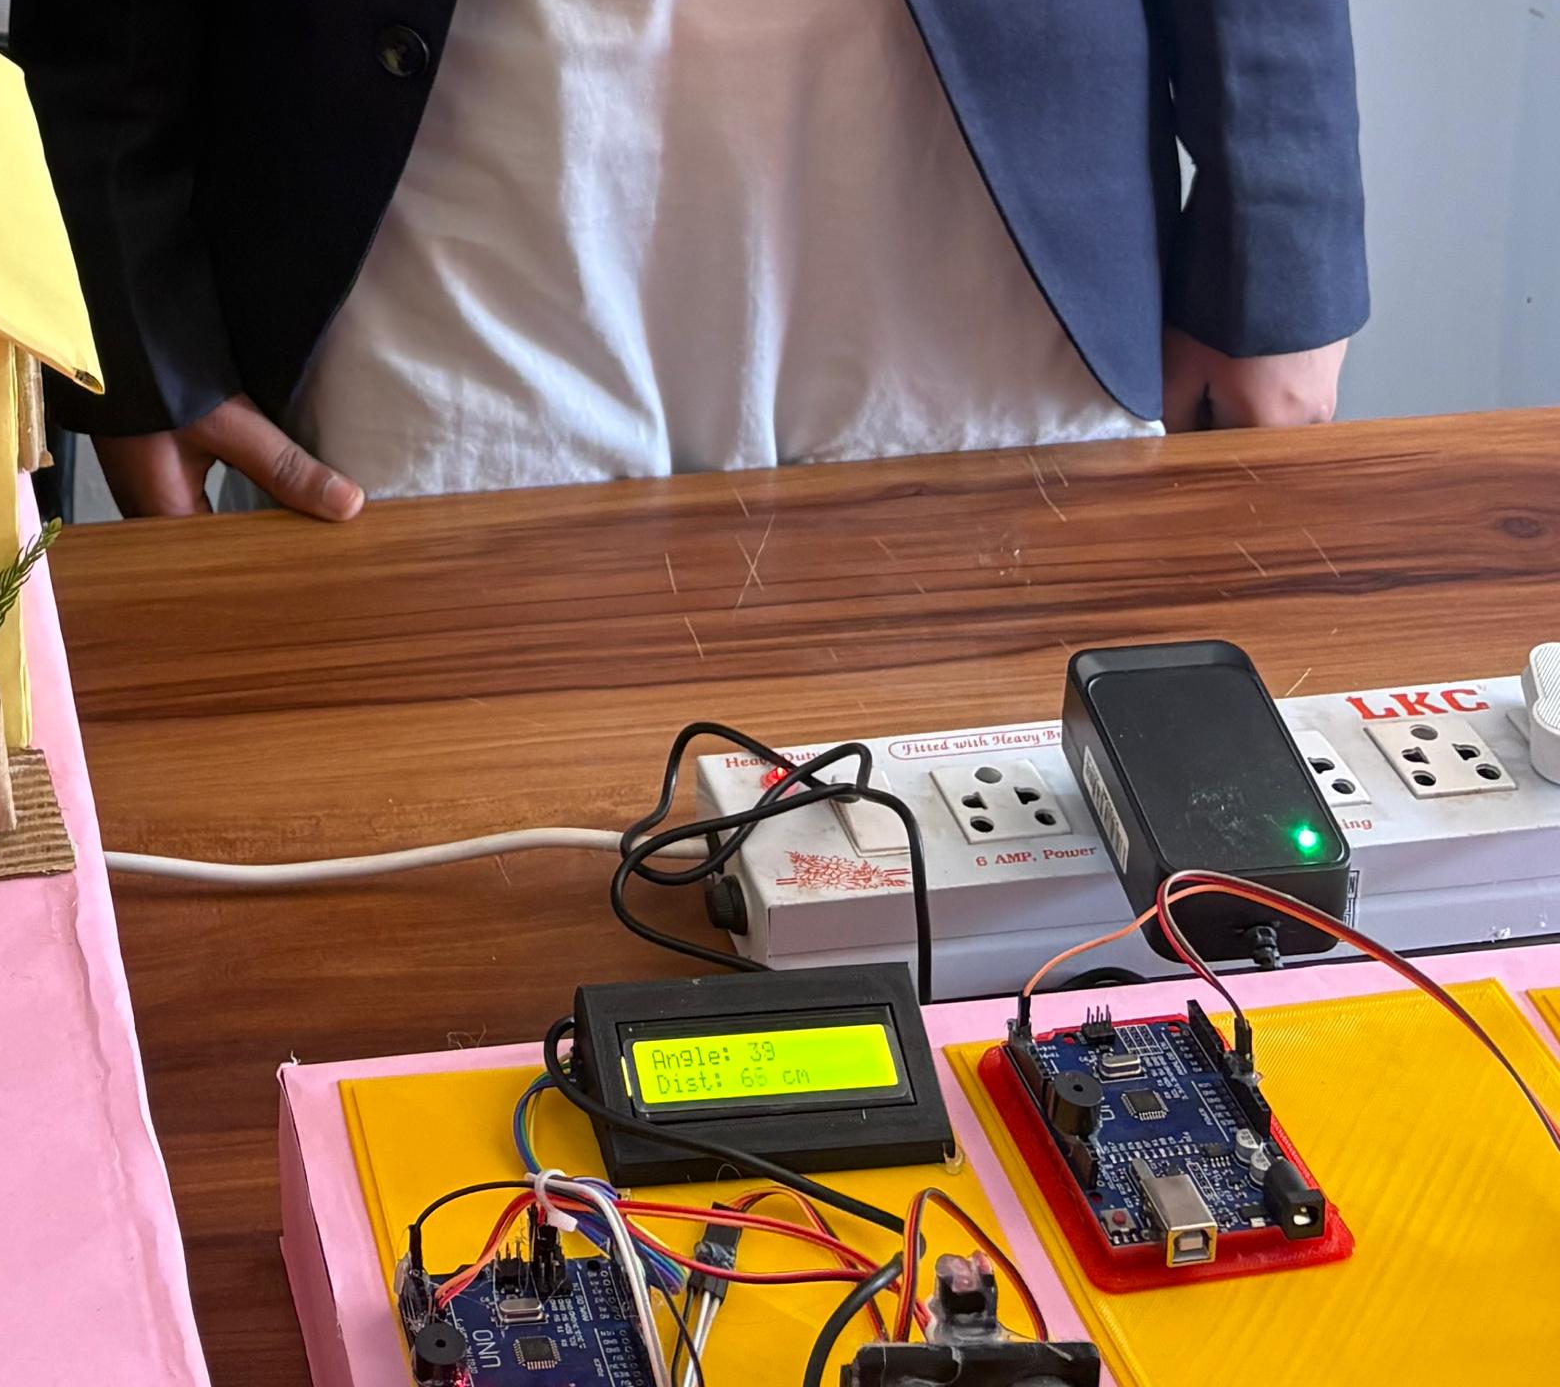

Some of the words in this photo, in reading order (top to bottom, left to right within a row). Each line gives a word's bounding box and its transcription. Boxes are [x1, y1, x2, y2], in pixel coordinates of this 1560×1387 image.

[1346, 689, 1489, 720] LKC
[902, 740, 948, 755] Fitted
[953, 735, 988, 749] with
[992, 730, 1040, 746] Heavy
[725, 756, 768, 768] Heav
[1342, 818, 1372, 831] ing
[976, 856, 987, 866] 6
[1043, 847, 1097, 860] Power
[652, 1047, 730, 1070] Angle:
[656, 1072, 722, 1094] Dist:
[783, 1068, 810, 1084] cm
[472, 1329, 501, 1368] UNO
